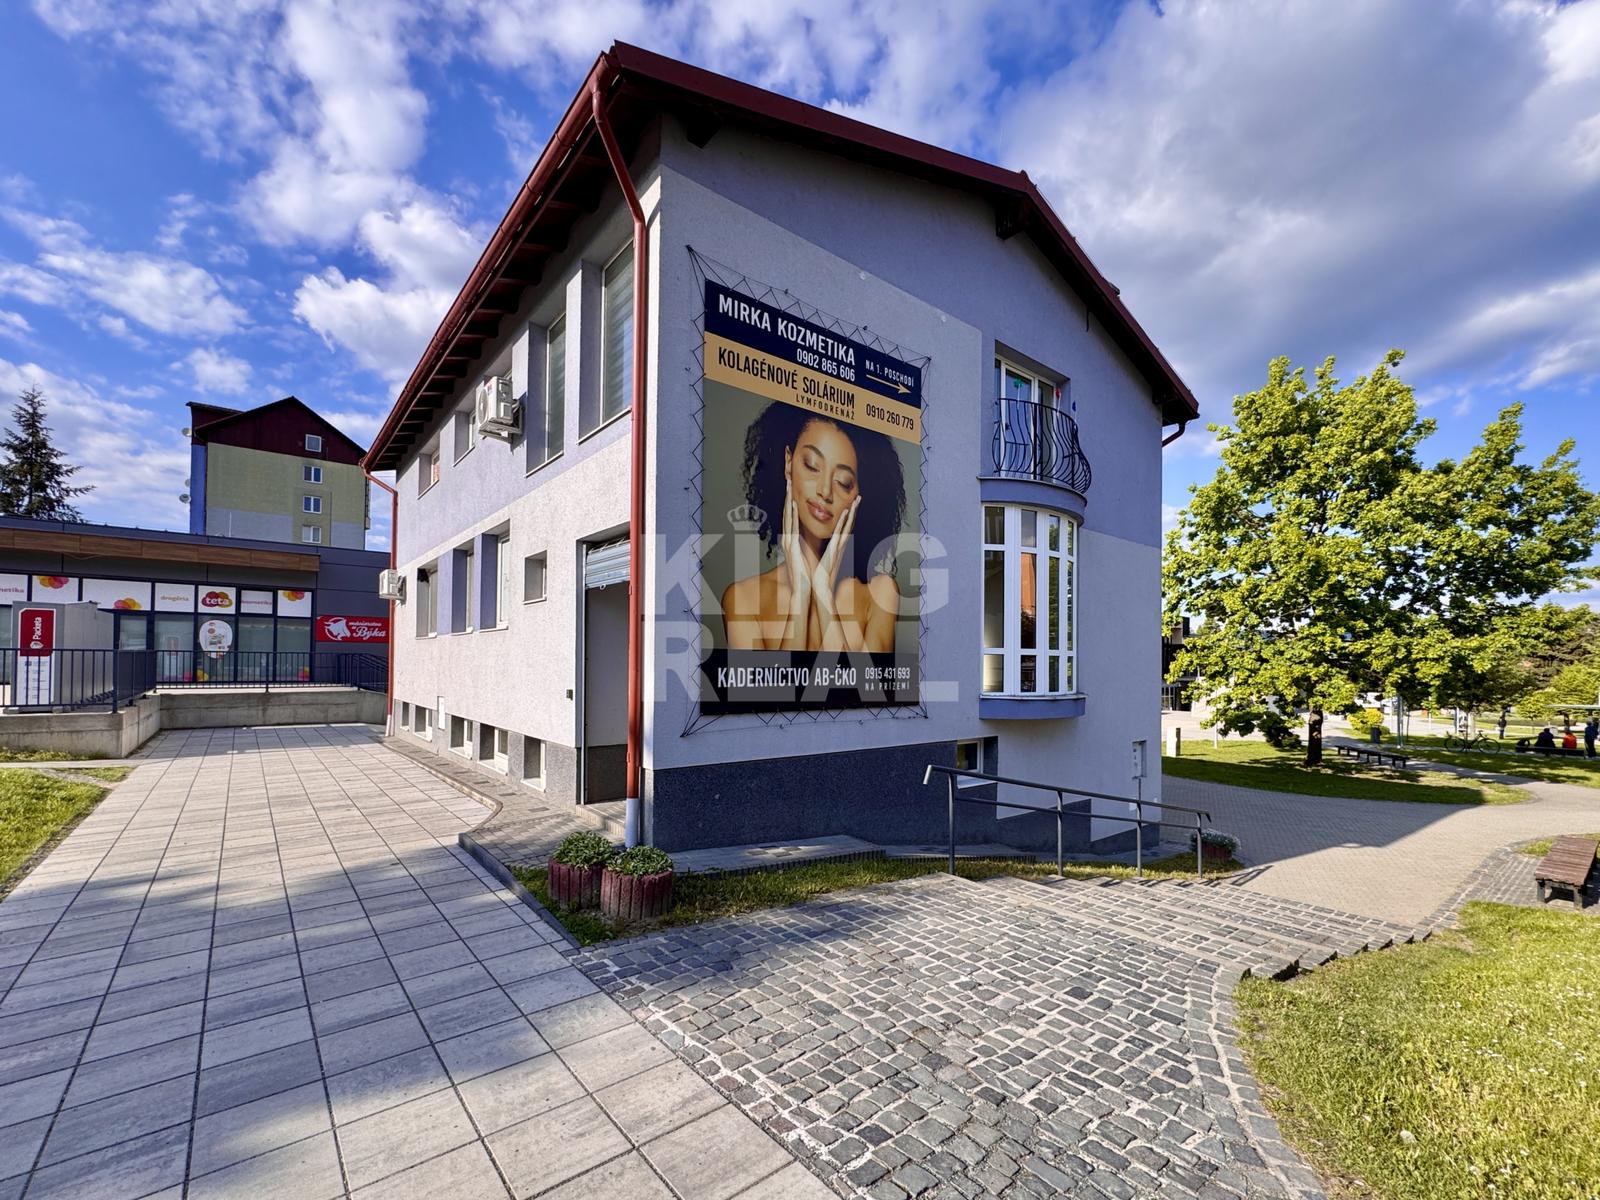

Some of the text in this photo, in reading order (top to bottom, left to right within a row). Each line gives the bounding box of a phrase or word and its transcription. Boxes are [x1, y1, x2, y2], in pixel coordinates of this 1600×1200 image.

[718, 294, 856, 366] MIRKA KOZMETIKA
[796, 348, 856, 382] 0902 865 606
[865, 359, 875, 372] NA
[876, 364, 883, 375] 1.
[718, 346, 855, 409] KOLAGÉNOVÉ SOLÁRIUM
[866, 403, 914, 430] 0910 260 779
[206, 597, 229, 606] teta
[353, 626, 387, 640] Býka
[717, 664, 857, 688] KADERNÍCTVO AB-ČKO
[865, 667, 911, 679] 0915 431 693
[865, 682, 875, 691] NA
